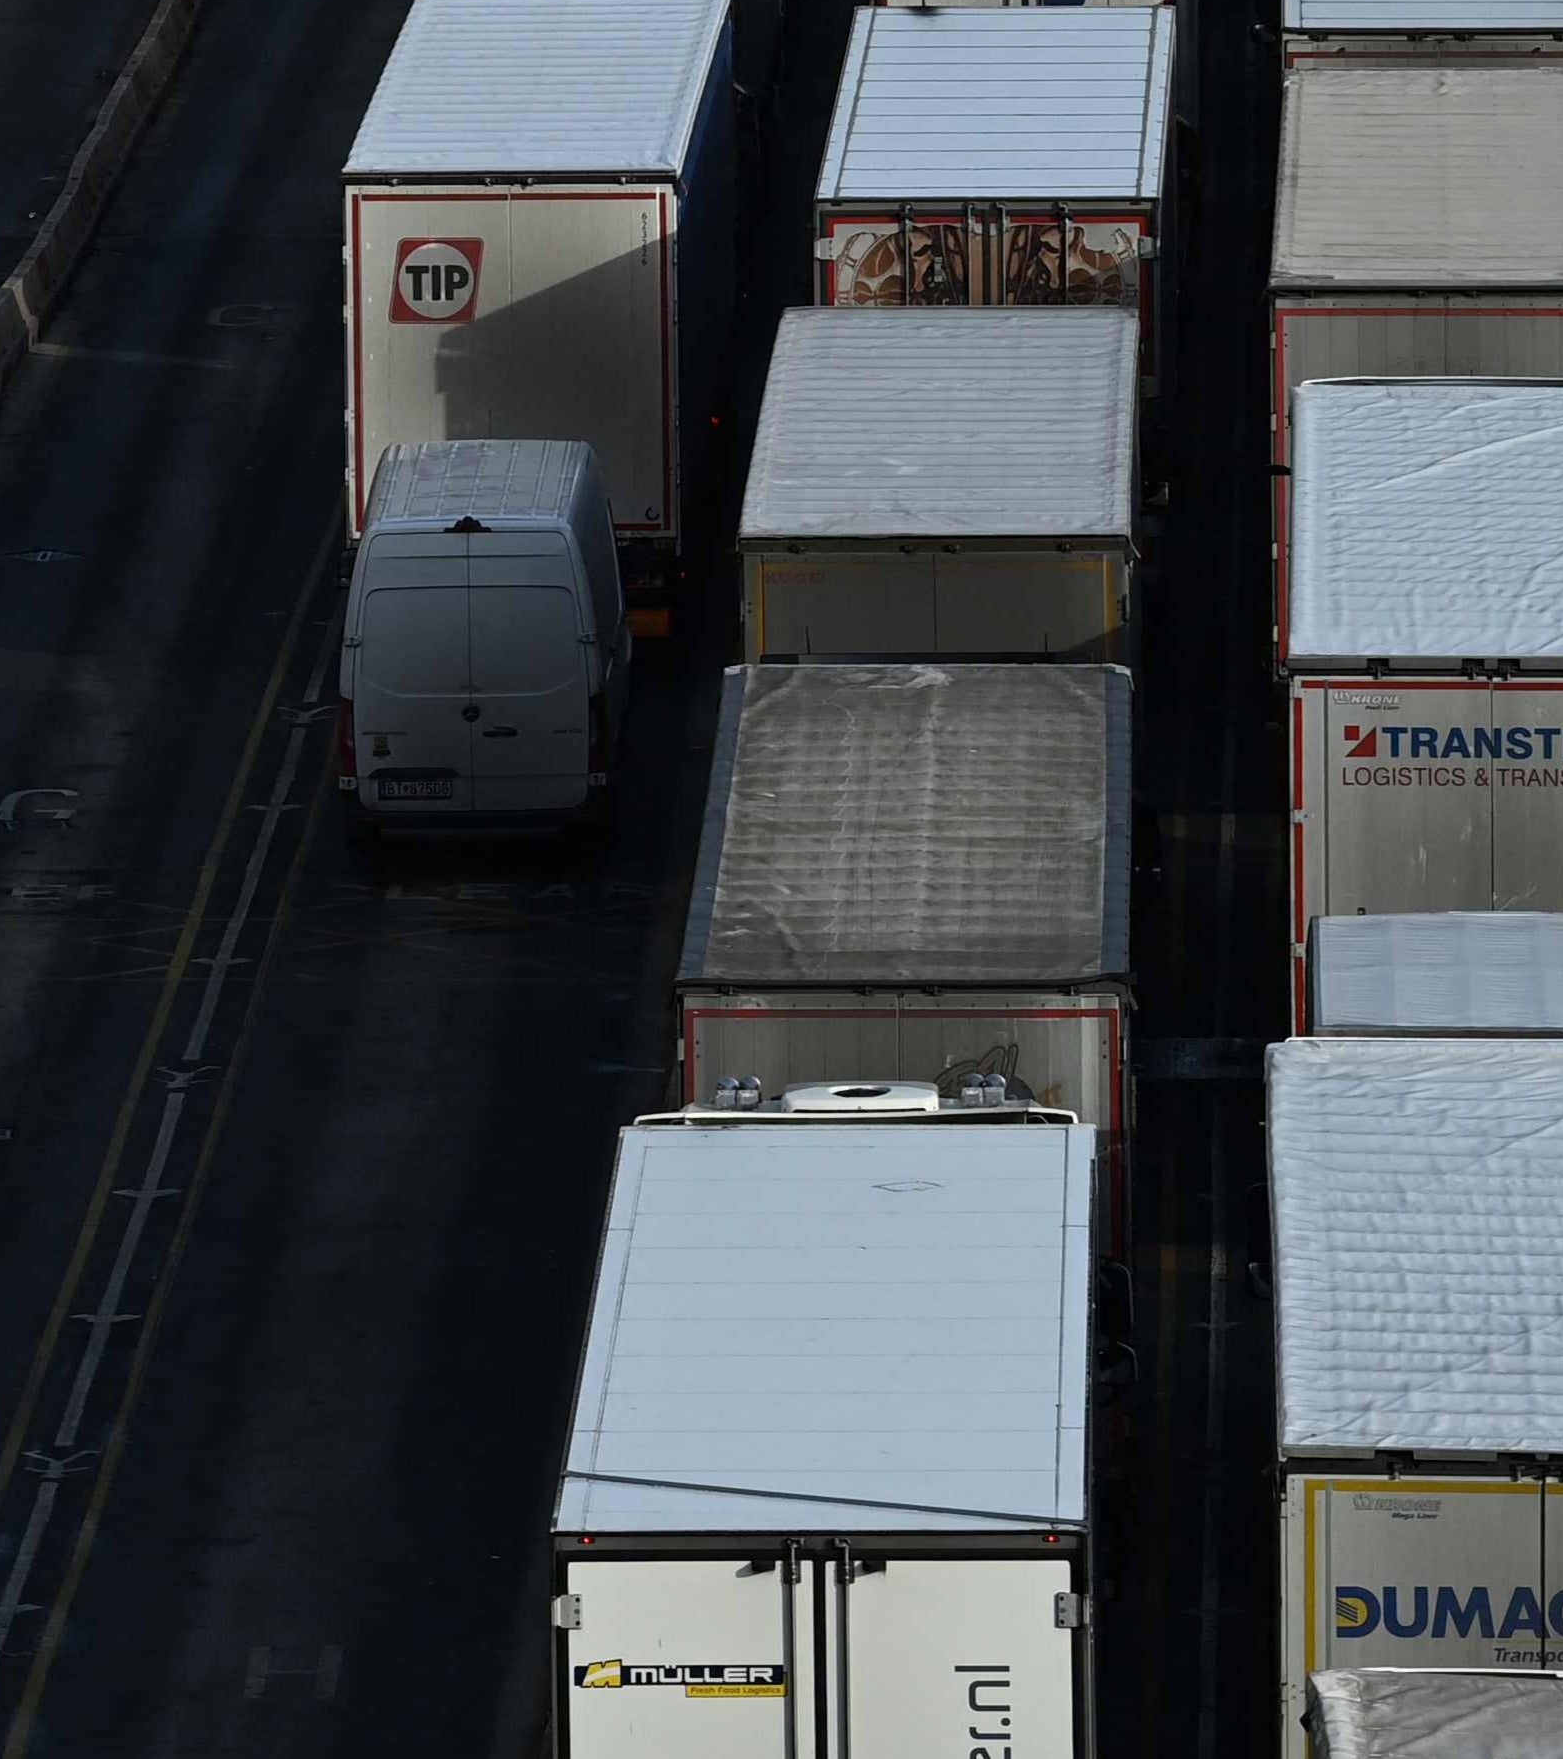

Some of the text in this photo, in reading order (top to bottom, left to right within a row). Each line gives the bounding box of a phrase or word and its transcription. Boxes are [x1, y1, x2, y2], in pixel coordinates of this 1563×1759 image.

[405, 265, 469, 301] TIP
[1351, 695, 1401, 704] KRONE
[1342, 767, 1466, 787] LOGISTICS
[1474, 767, 1489, 787] &
[630, 1664, 773, 1684] MÜLLER
[690, 1685, 781, 1697] Fresh Food Logistics
